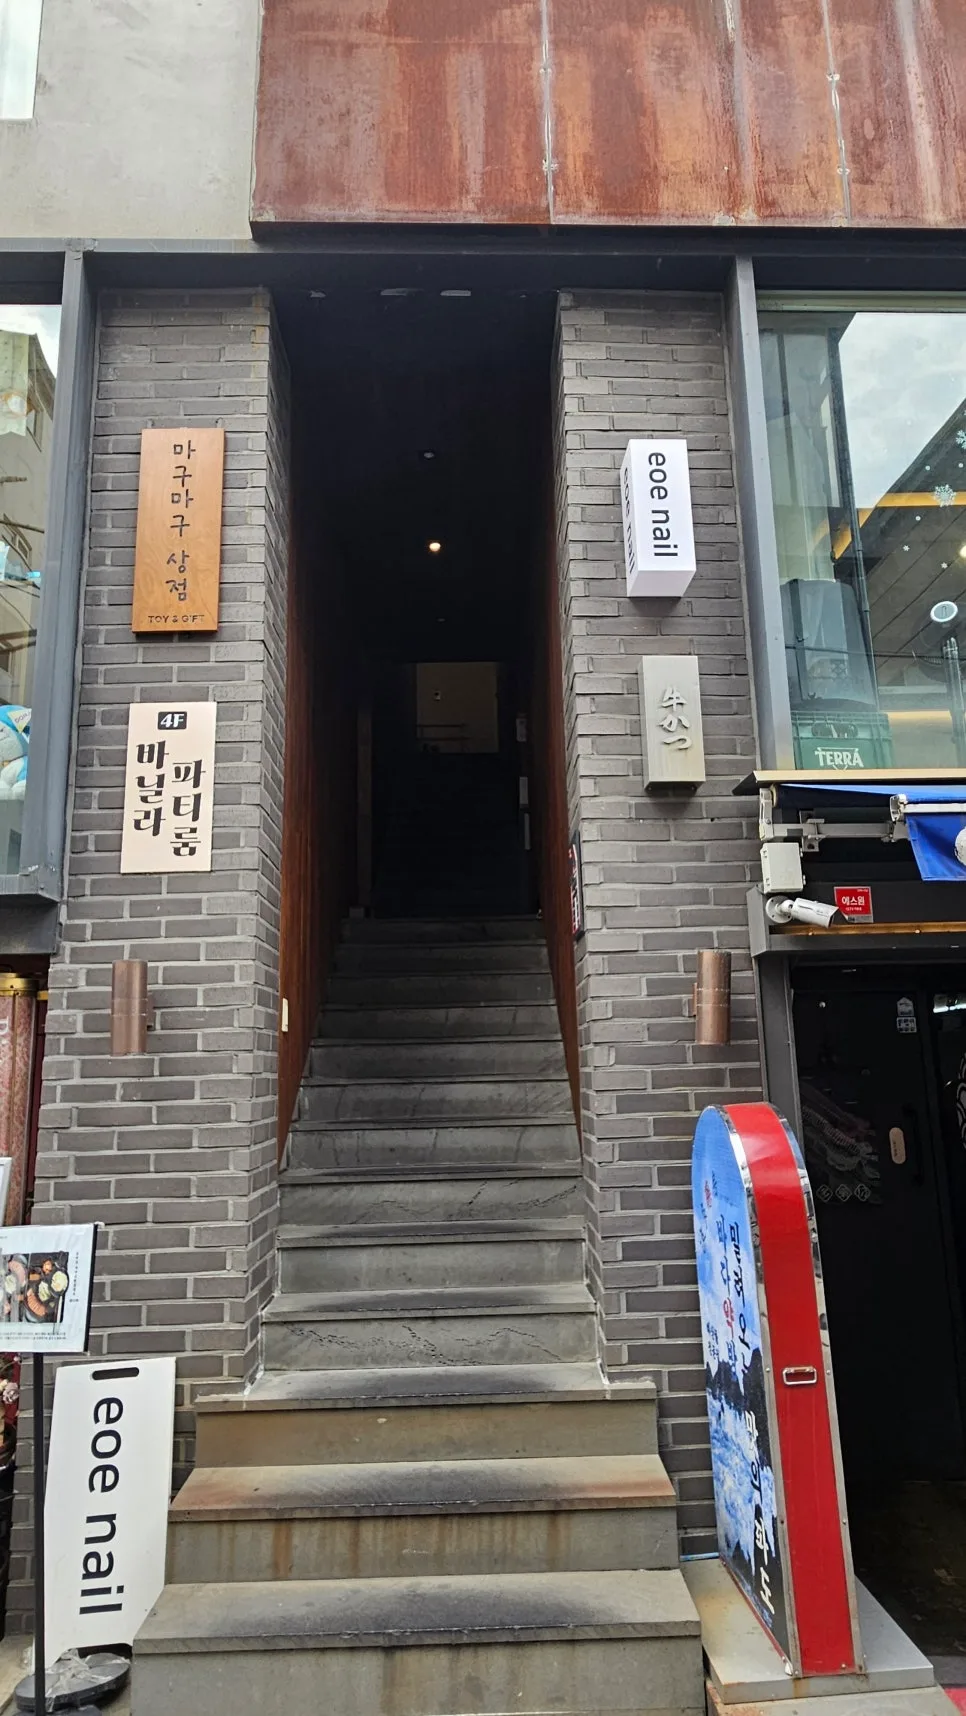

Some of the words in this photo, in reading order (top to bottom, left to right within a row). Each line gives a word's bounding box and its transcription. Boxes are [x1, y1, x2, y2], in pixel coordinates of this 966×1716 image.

[170, 439, 196, 538] 마구마구
[648, 451, 668, 500] eoe
[652, 509, 679, 557] nail
[166, 550, 190, 600] 상점
[148, 614, 169, 623] TOY
[171, 615, 178, 623] &
[181, 614, 205, 623] GIFT
[160, 713, 185, 728] 4F
[659, 685, 693, 750] 牛かつ
[814, 747, 864, 767] TERRA
[133, 740, 169, 836] 바닐라
[170, 759, 206, 857] 파티룸
[841, 895, 865, 906] 에스원
[88, 1396, 124, 1494] eoe
[78, 1512, 124, 1616] nail
[755, 1517, 774, 1614] 파도
